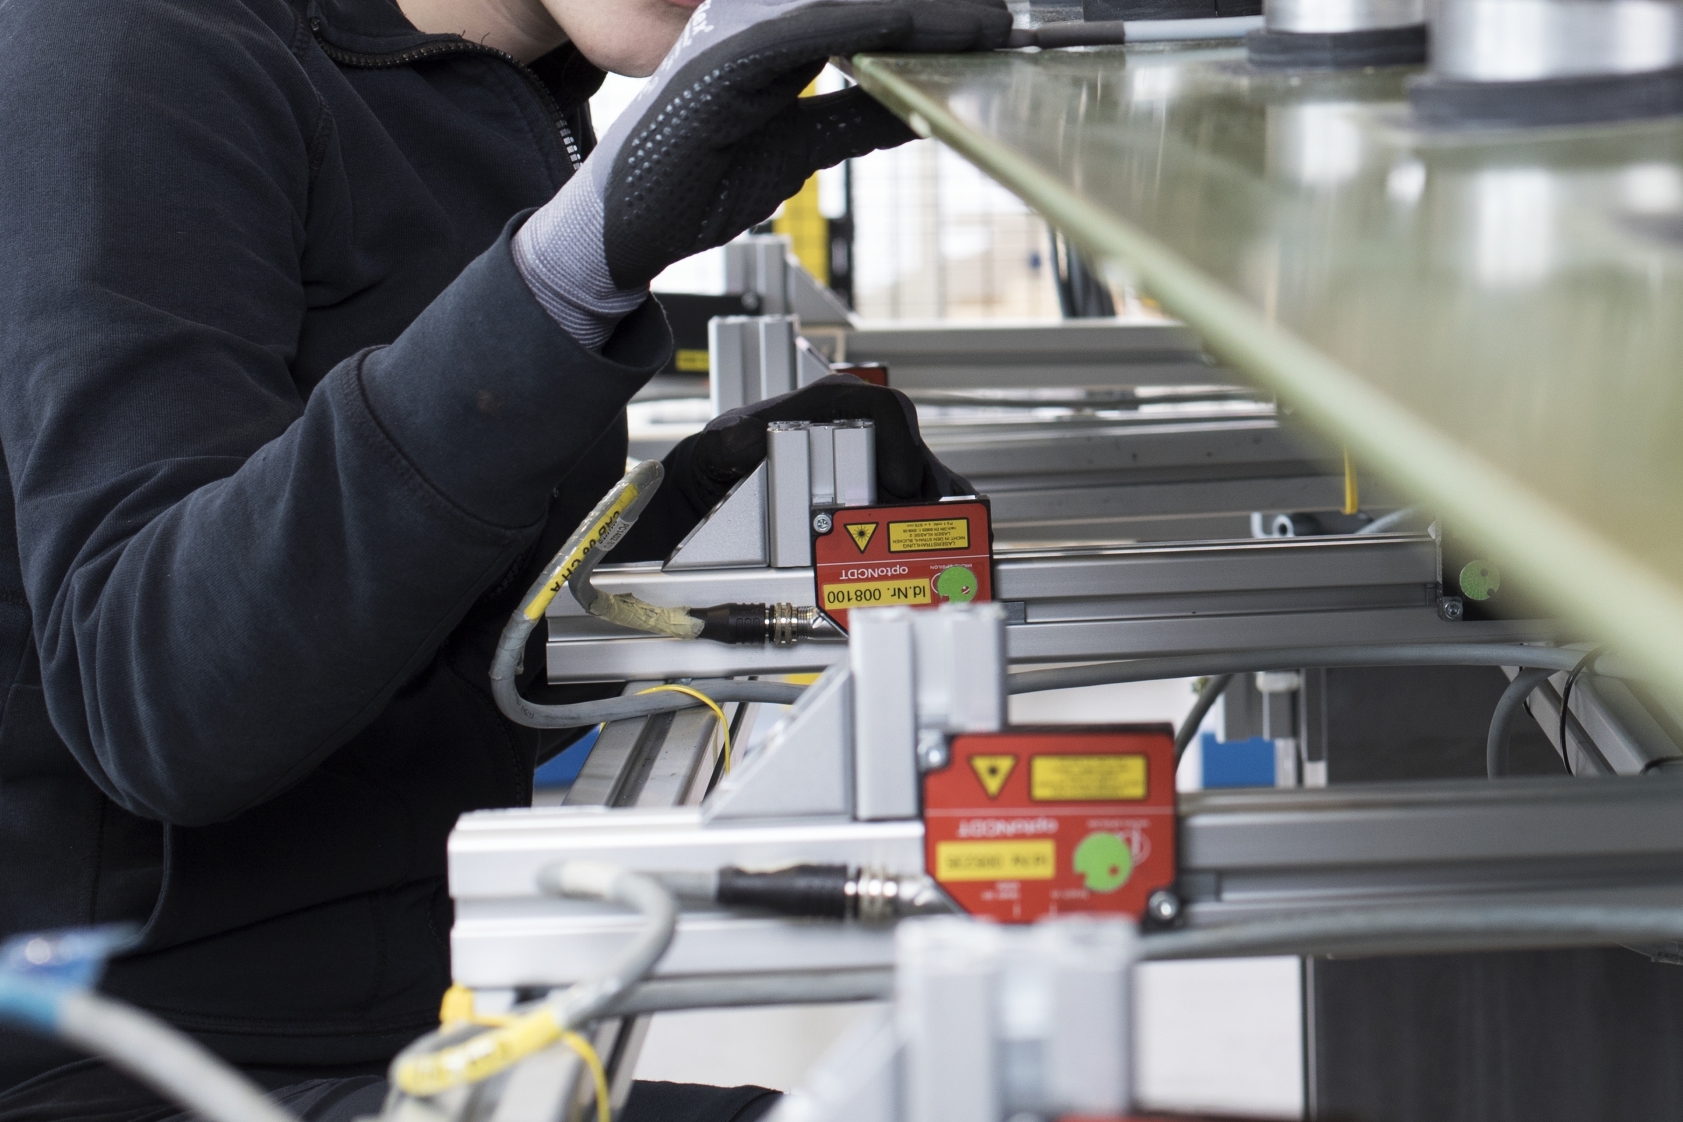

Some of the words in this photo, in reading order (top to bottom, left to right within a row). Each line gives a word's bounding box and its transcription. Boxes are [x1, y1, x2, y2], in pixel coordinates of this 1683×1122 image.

[902, 540, 955, 548] LASERSTRAHLUNG
[841, 565, 909, 579] optoNCDT
[827, 588, 882, 604] 008100
[886, 585, 926, 601] Id.Nr.
